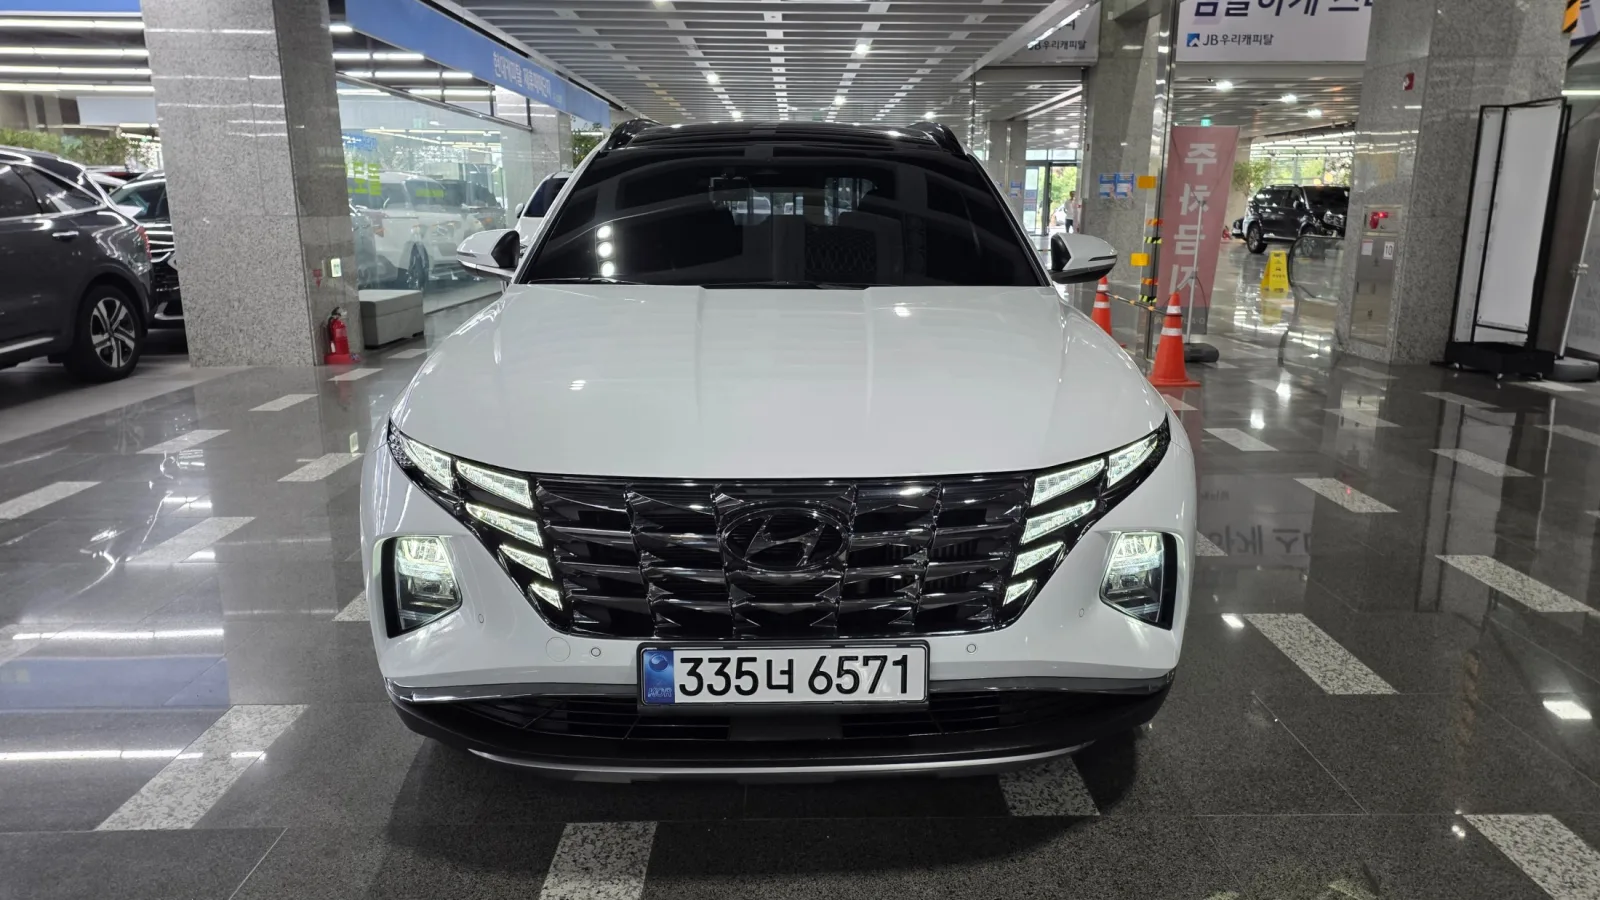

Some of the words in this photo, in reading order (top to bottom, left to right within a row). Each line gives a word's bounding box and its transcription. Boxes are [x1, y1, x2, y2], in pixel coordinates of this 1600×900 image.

[1202, 34, 1274, 46] JB우리캐피탈
[679, 656, 794, 696] 335너
[808, 654, 908, 695] 6571
